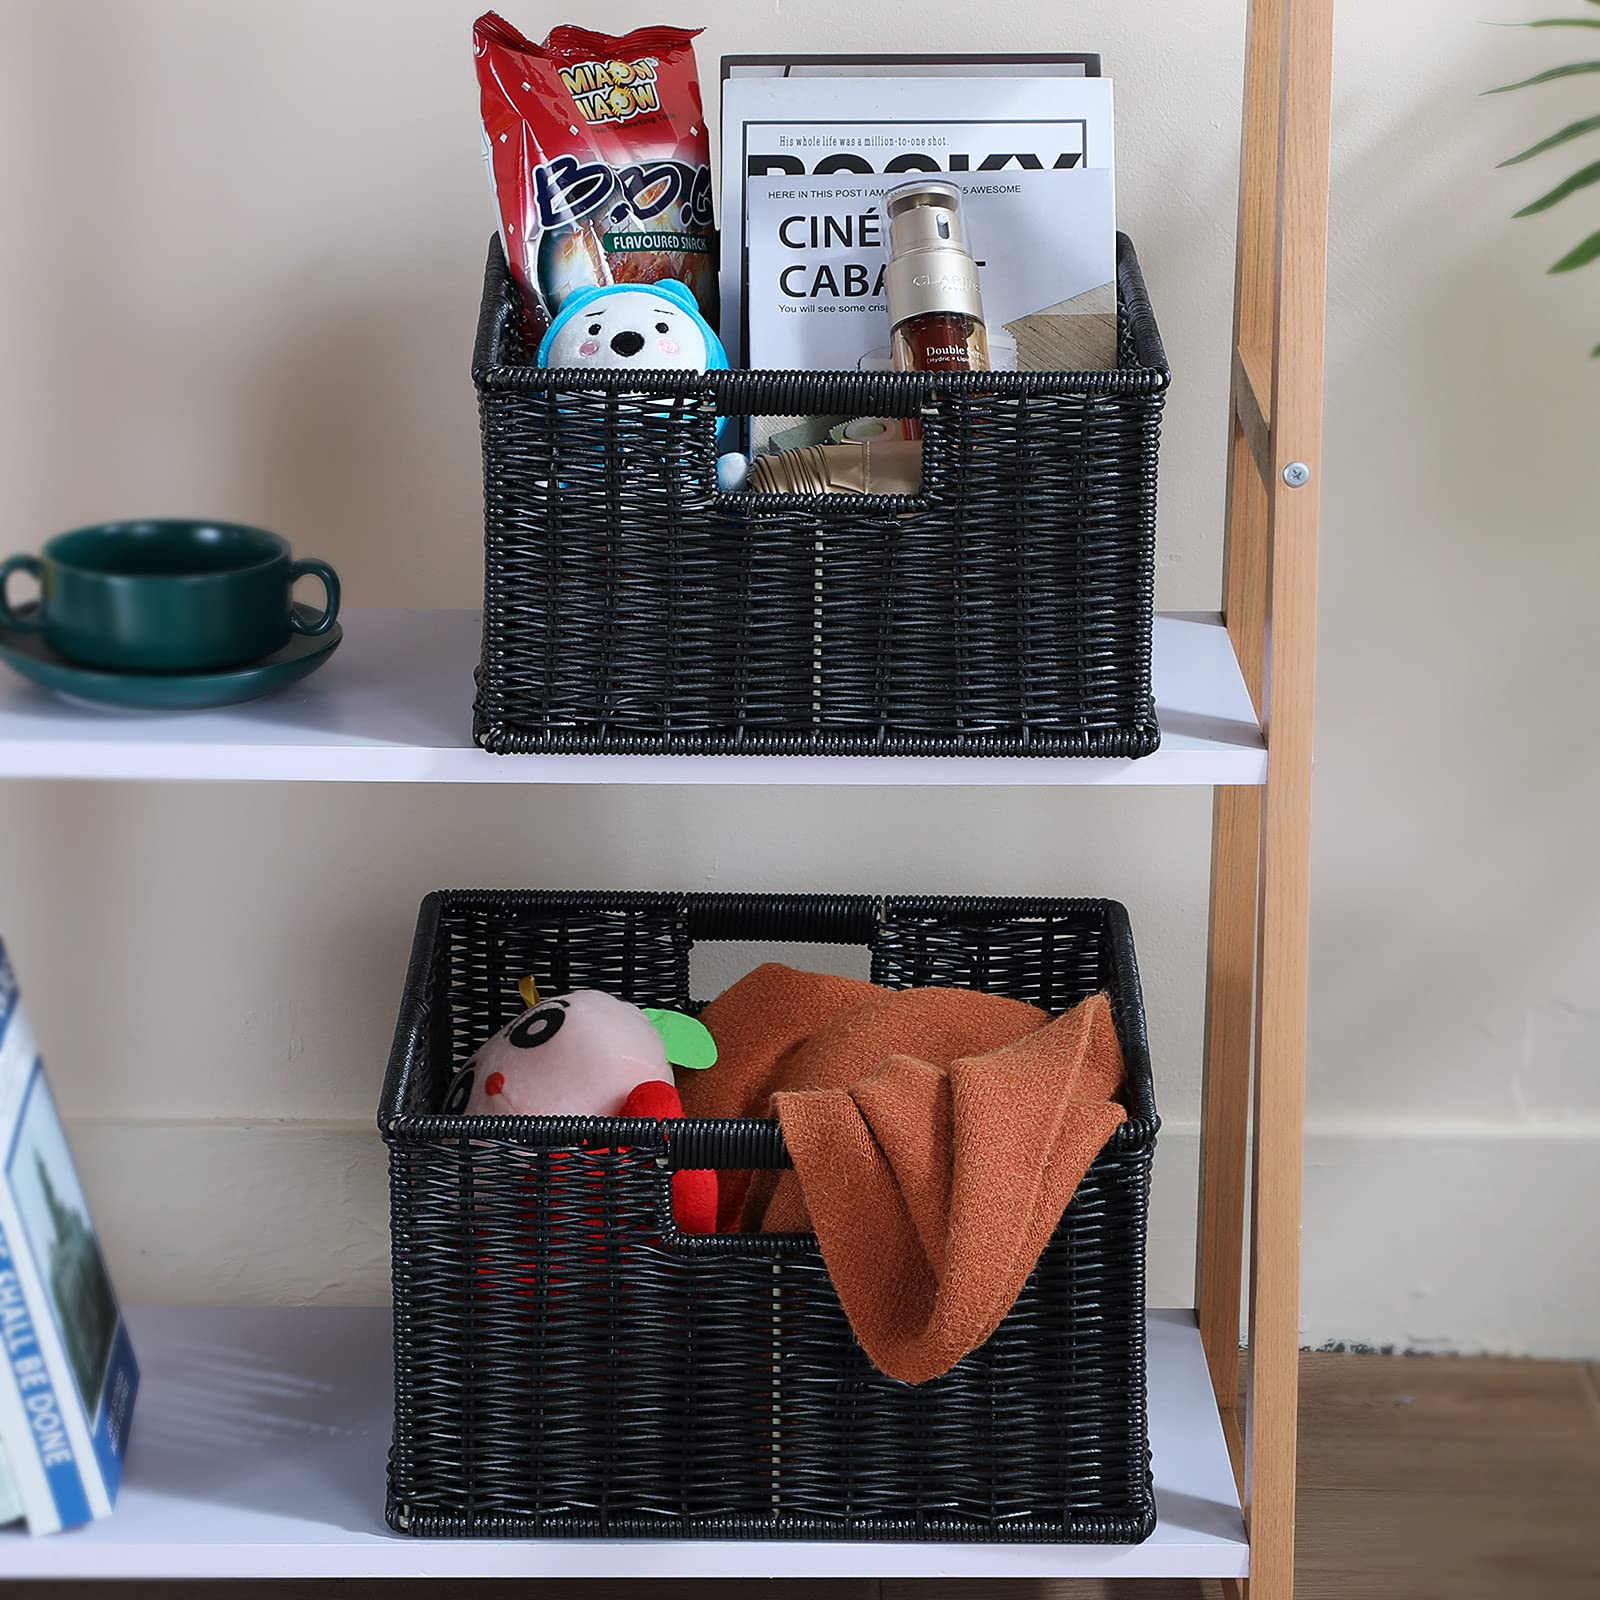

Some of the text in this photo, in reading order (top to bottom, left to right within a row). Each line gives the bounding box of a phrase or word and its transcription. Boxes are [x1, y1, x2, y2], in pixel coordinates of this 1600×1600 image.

[574, 84, 657, 121] IAOW
[779, 136, 950, 147] His whole life was a million-to-one shot.
[768, 190, 795, 199] HERE
[798, 190, 808, 199] IN
[811, 190, 833, 199] THIS
[835, 189, 863, 198] POST
[869, 189, 885, 197] AM
[970, 184, 1021, 195] AWESOME
[613, 234, 707, 252] FLAVOURED SNACK
[778, 304, 797, 313] You
[800, 304, 815, 313] will
[818, 304, 836, 313] see
[838, 304, 866, 313] some
[926, 344, 966, 357] Double
[15, 1353, 48, 1390] BE
[27, 1391, 71, 1468] DONE
